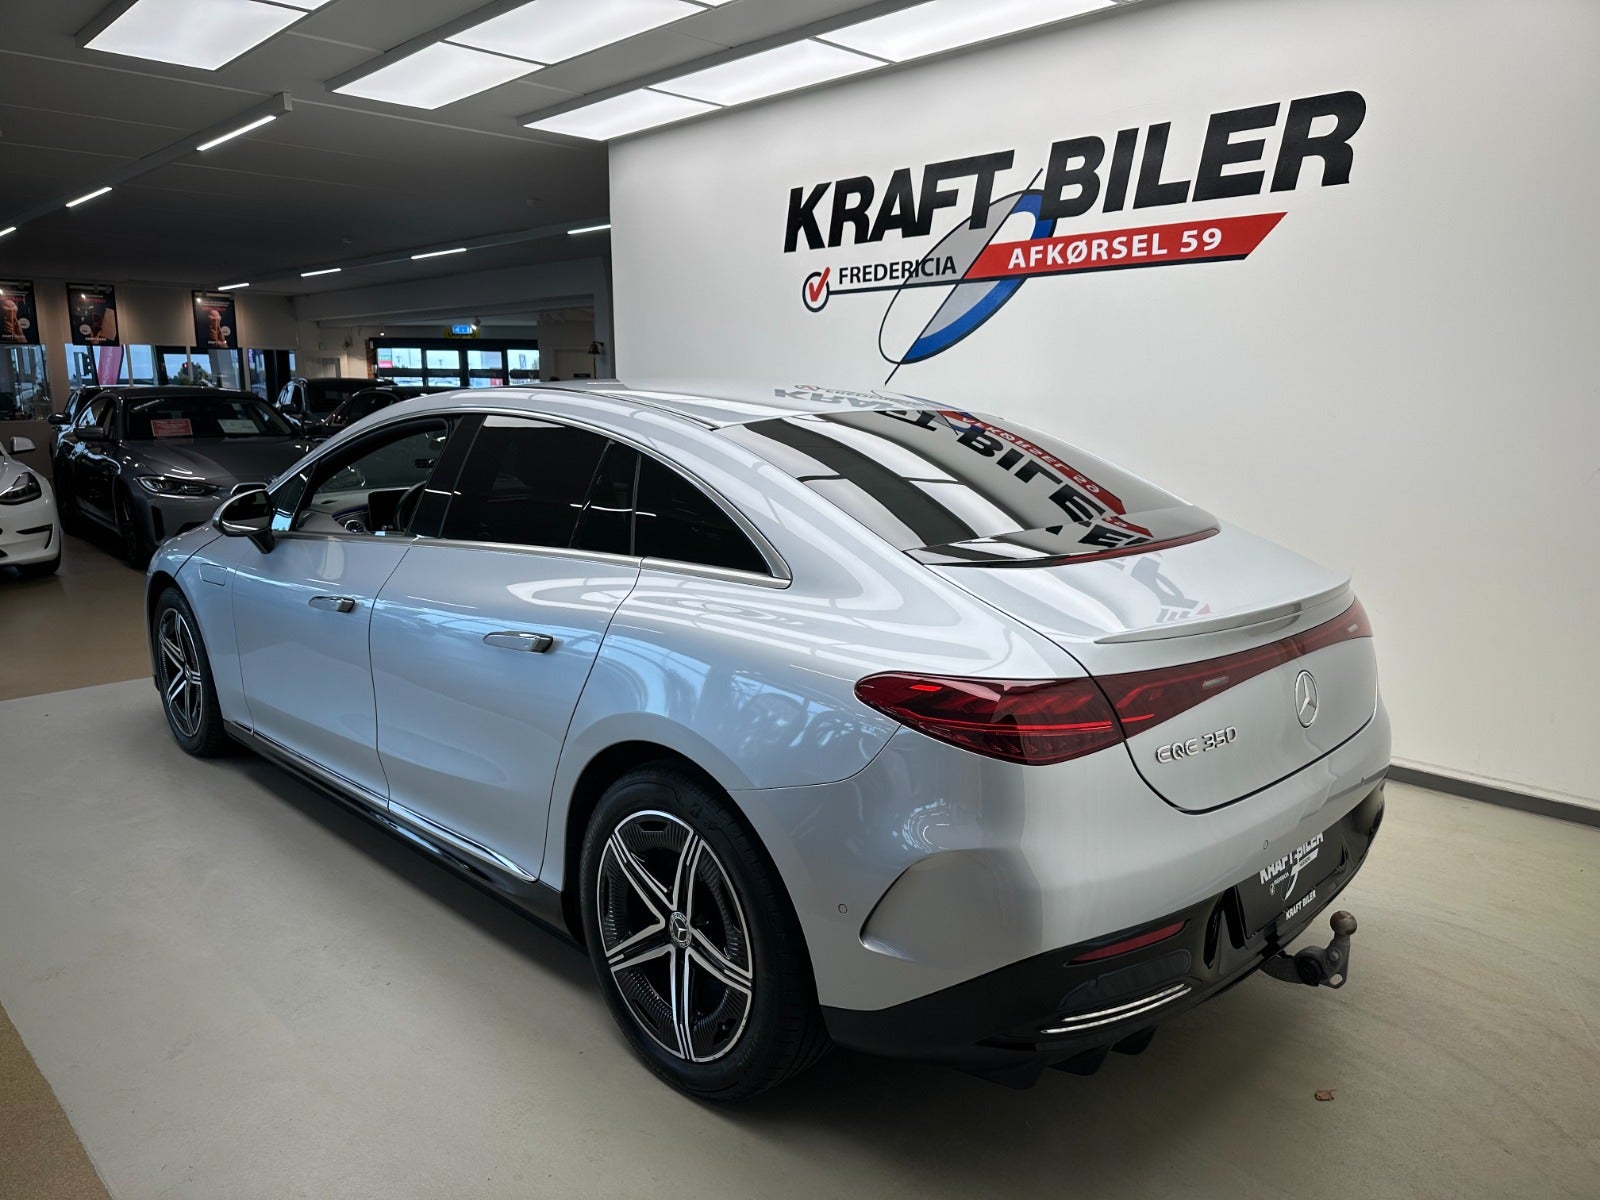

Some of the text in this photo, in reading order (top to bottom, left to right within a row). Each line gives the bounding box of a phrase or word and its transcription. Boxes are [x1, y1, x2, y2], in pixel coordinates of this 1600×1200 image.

[784, 90, 1367, 253] KRAFT BILER
[1008, 227, 1223, 270] AFKØRSEL 59
[839, 255, 957, 285] FREDERICIA
[1156, 726, 1237, 763] EQE 350
[1286, 889, 1316, 920] KRAFT BILER
